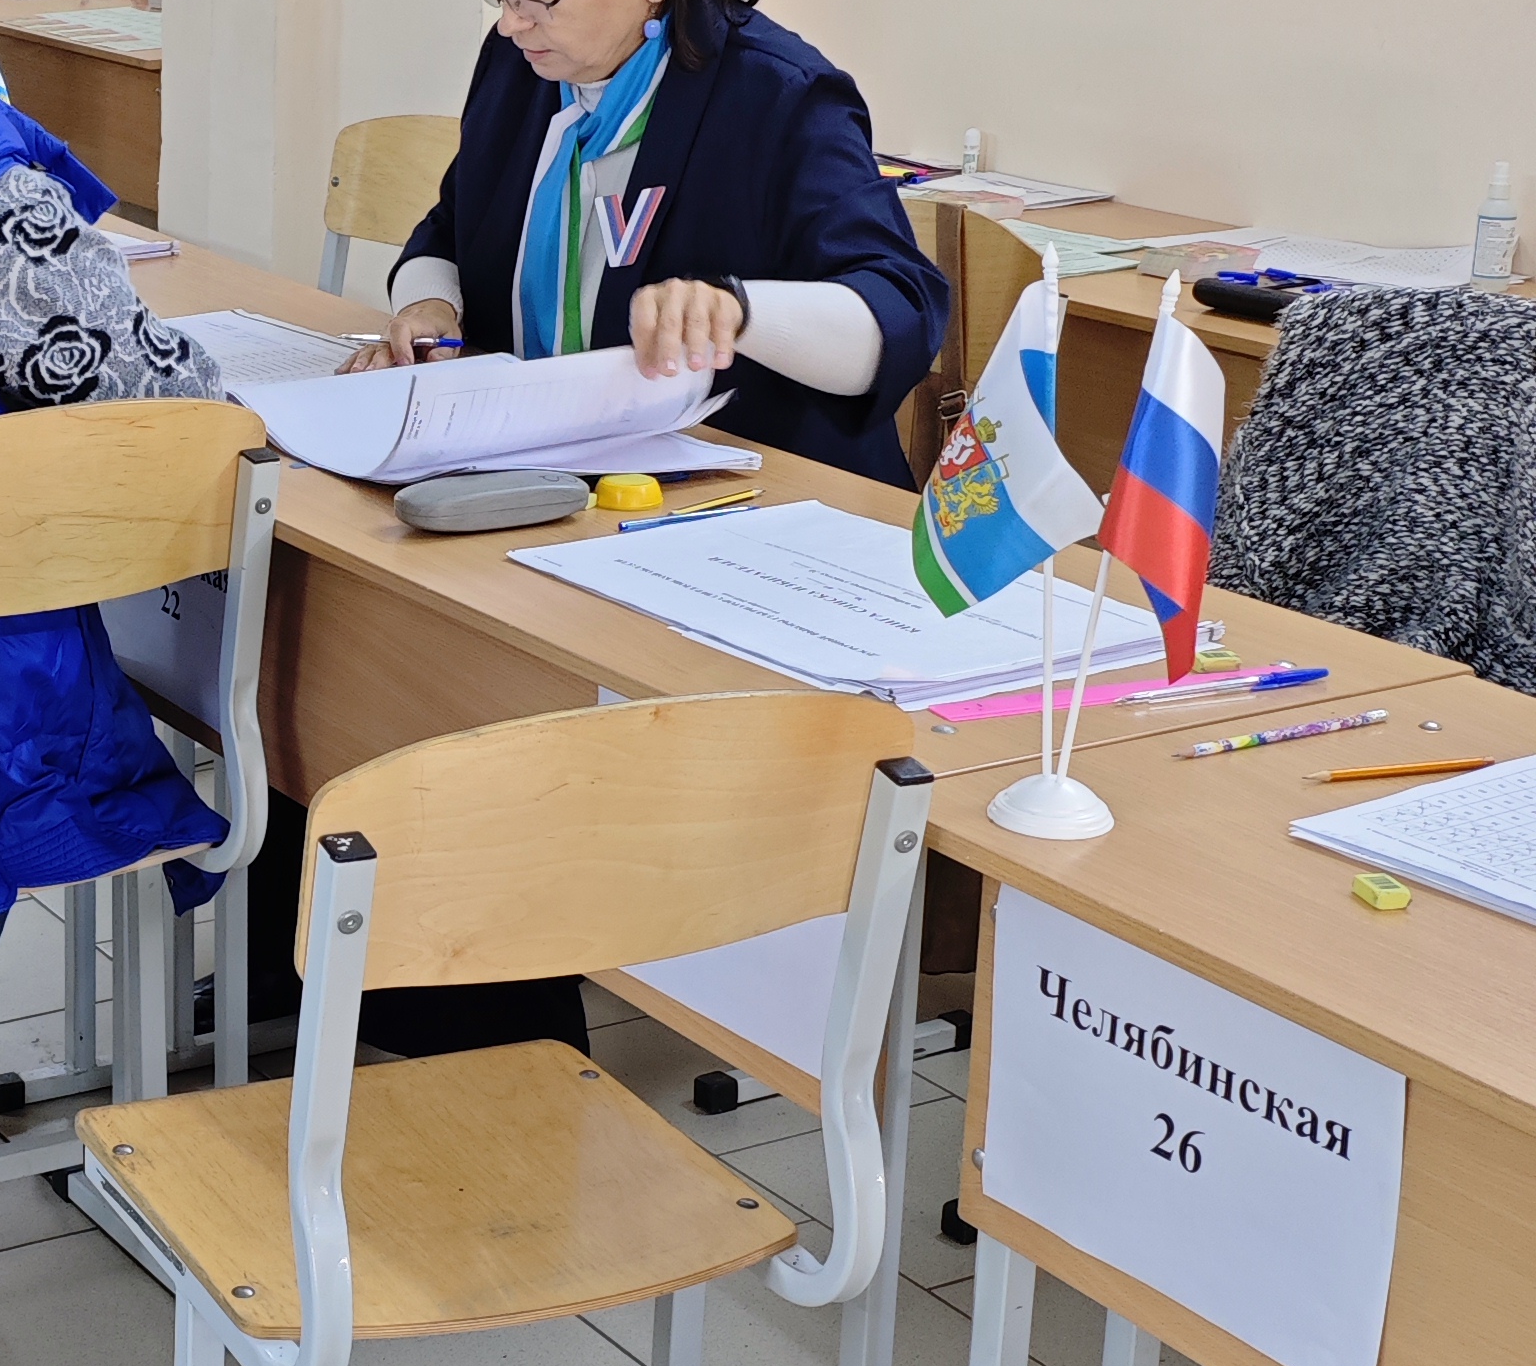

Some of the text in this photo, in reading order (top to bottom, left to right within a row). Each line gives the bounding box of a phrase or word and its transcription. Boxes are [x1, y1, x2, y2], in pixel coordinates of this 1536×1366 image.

[160, 585, 181, 621] 22
[1036, 964, 1354, 1162] Челябинская
[1149, 1111, 1207, 1174] 26
